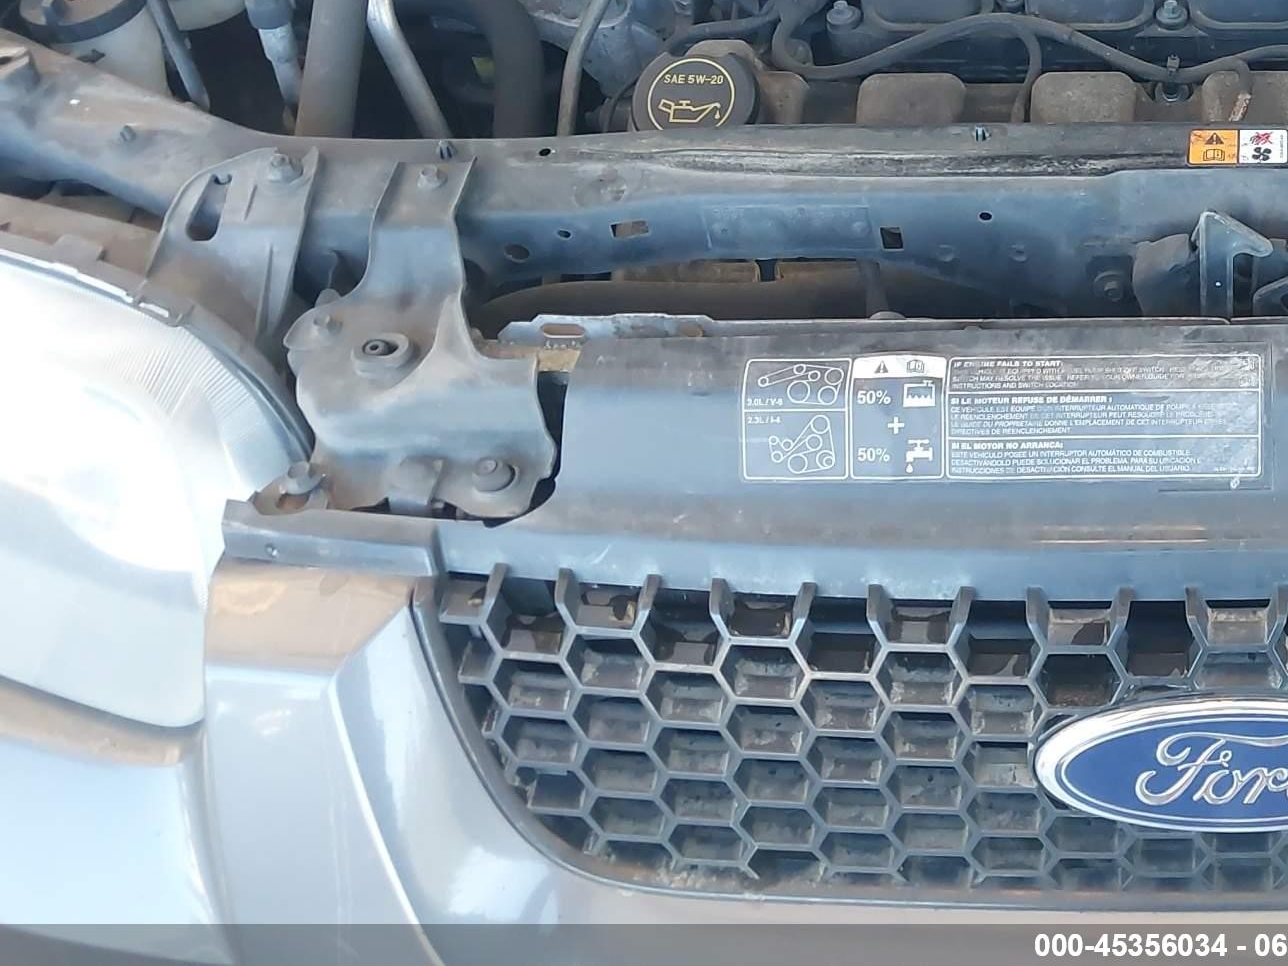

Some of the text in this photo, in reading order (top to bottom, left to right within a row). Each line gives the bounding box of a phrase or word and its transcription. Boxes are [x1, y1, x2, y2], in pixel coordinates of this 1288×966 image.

[663, 74, 725, 85] SAE 5W-20
[857, 391, 891, 404] 50%
[857, 448, 890, 462] 50%
